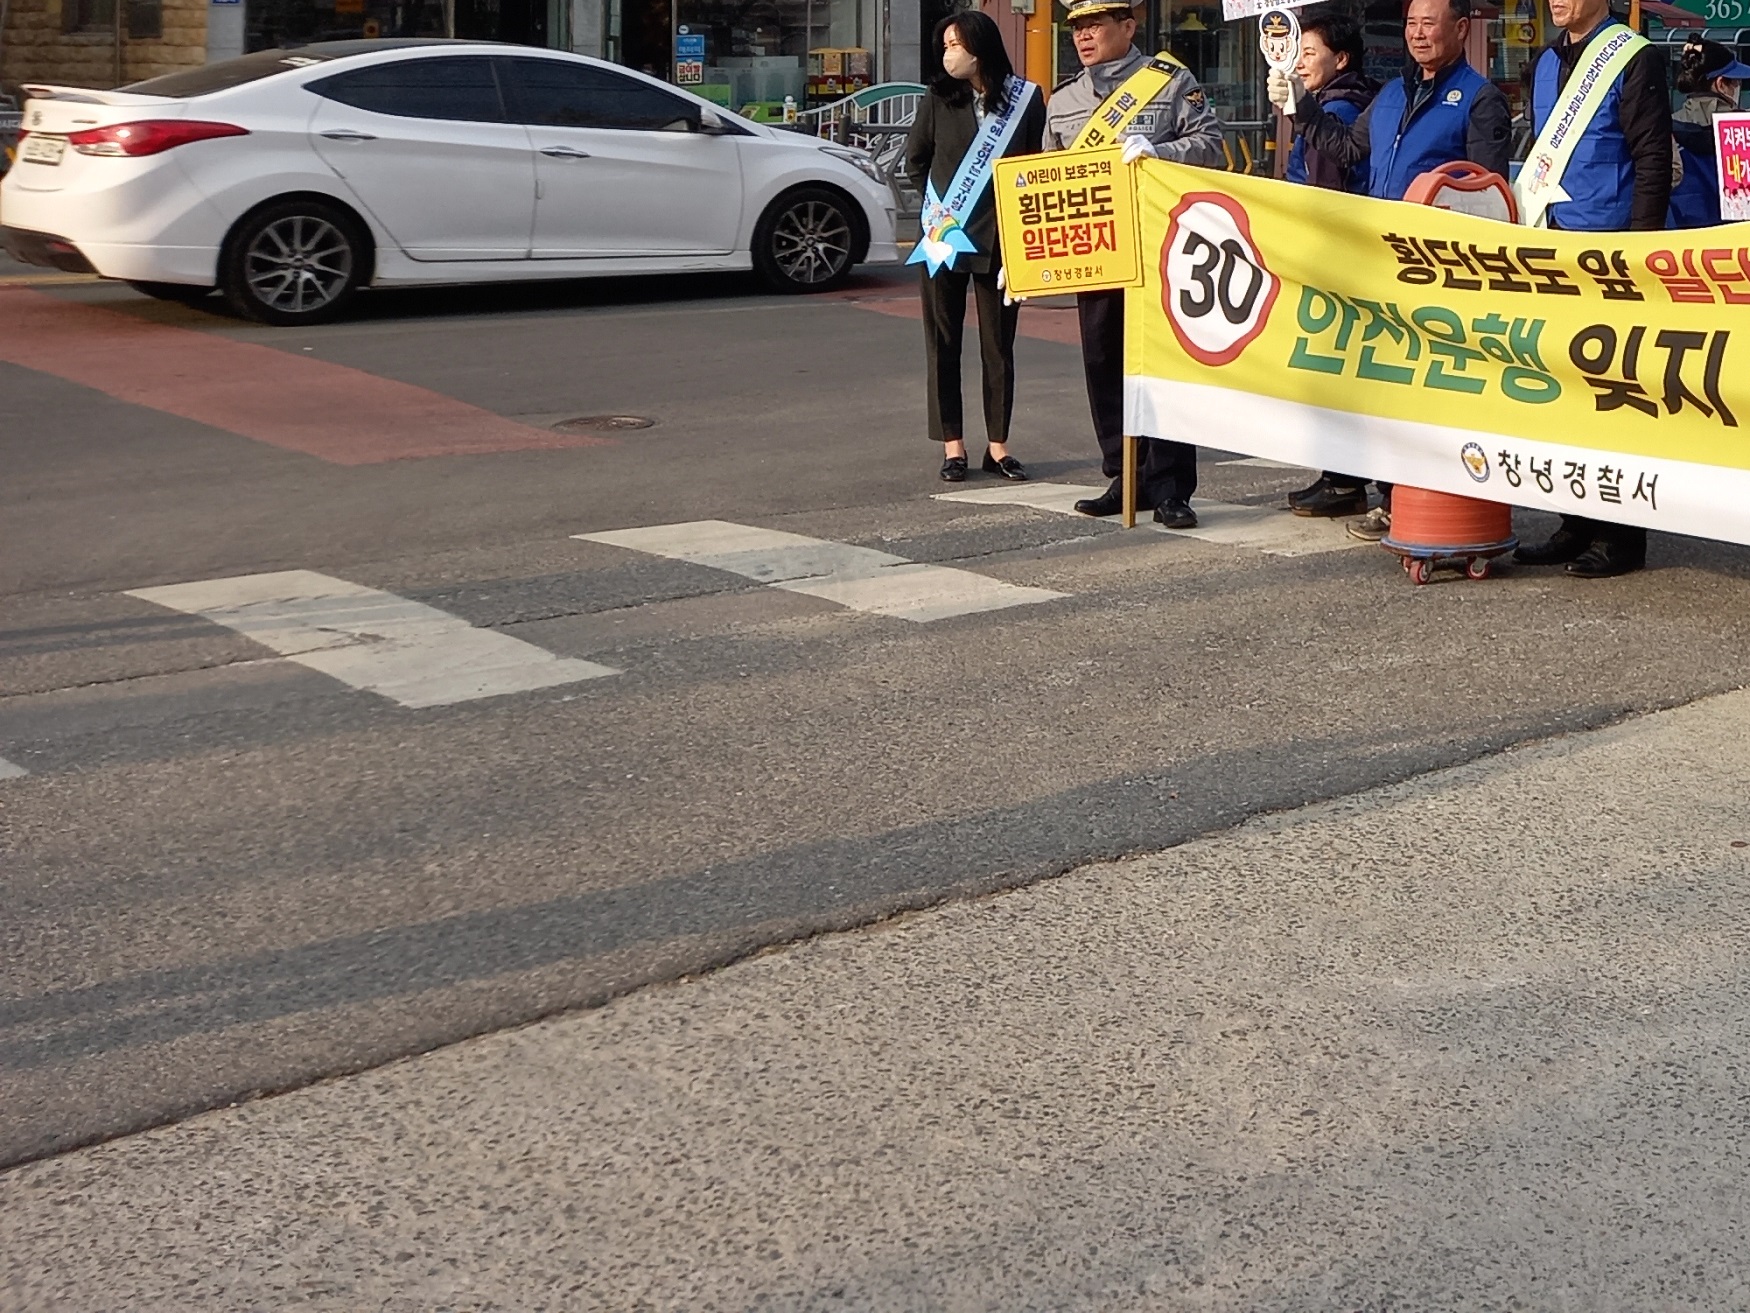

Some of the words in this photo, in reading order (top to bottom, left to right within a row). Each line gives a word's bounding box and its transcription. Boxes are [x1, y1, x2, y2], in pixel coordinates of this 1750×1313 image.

[1102, 91, 1138, 129] 함께
[1027, 166, 1062, 185] 어린이
[1065, 160, 1112, 180] 보호구역
[1726, 154, 1750, 183] 내가
[1018, 184, 1114, 225] 횡단보도
[1022, 219, 1117, 261] 일단정지
[1054, 265, 1103, 281] 창녕경찰서
[1180, 230, 1262, 325] 30
[1380, 231, 1581, 296] 횡단보도
[1577, 249, 1645, 302] 앞
[1287, 283, 1562, 405] 안전운행
[1568, 323, 1739, 428] 잊지
[1497, 448, 1660, 511] 창녕경찰서
